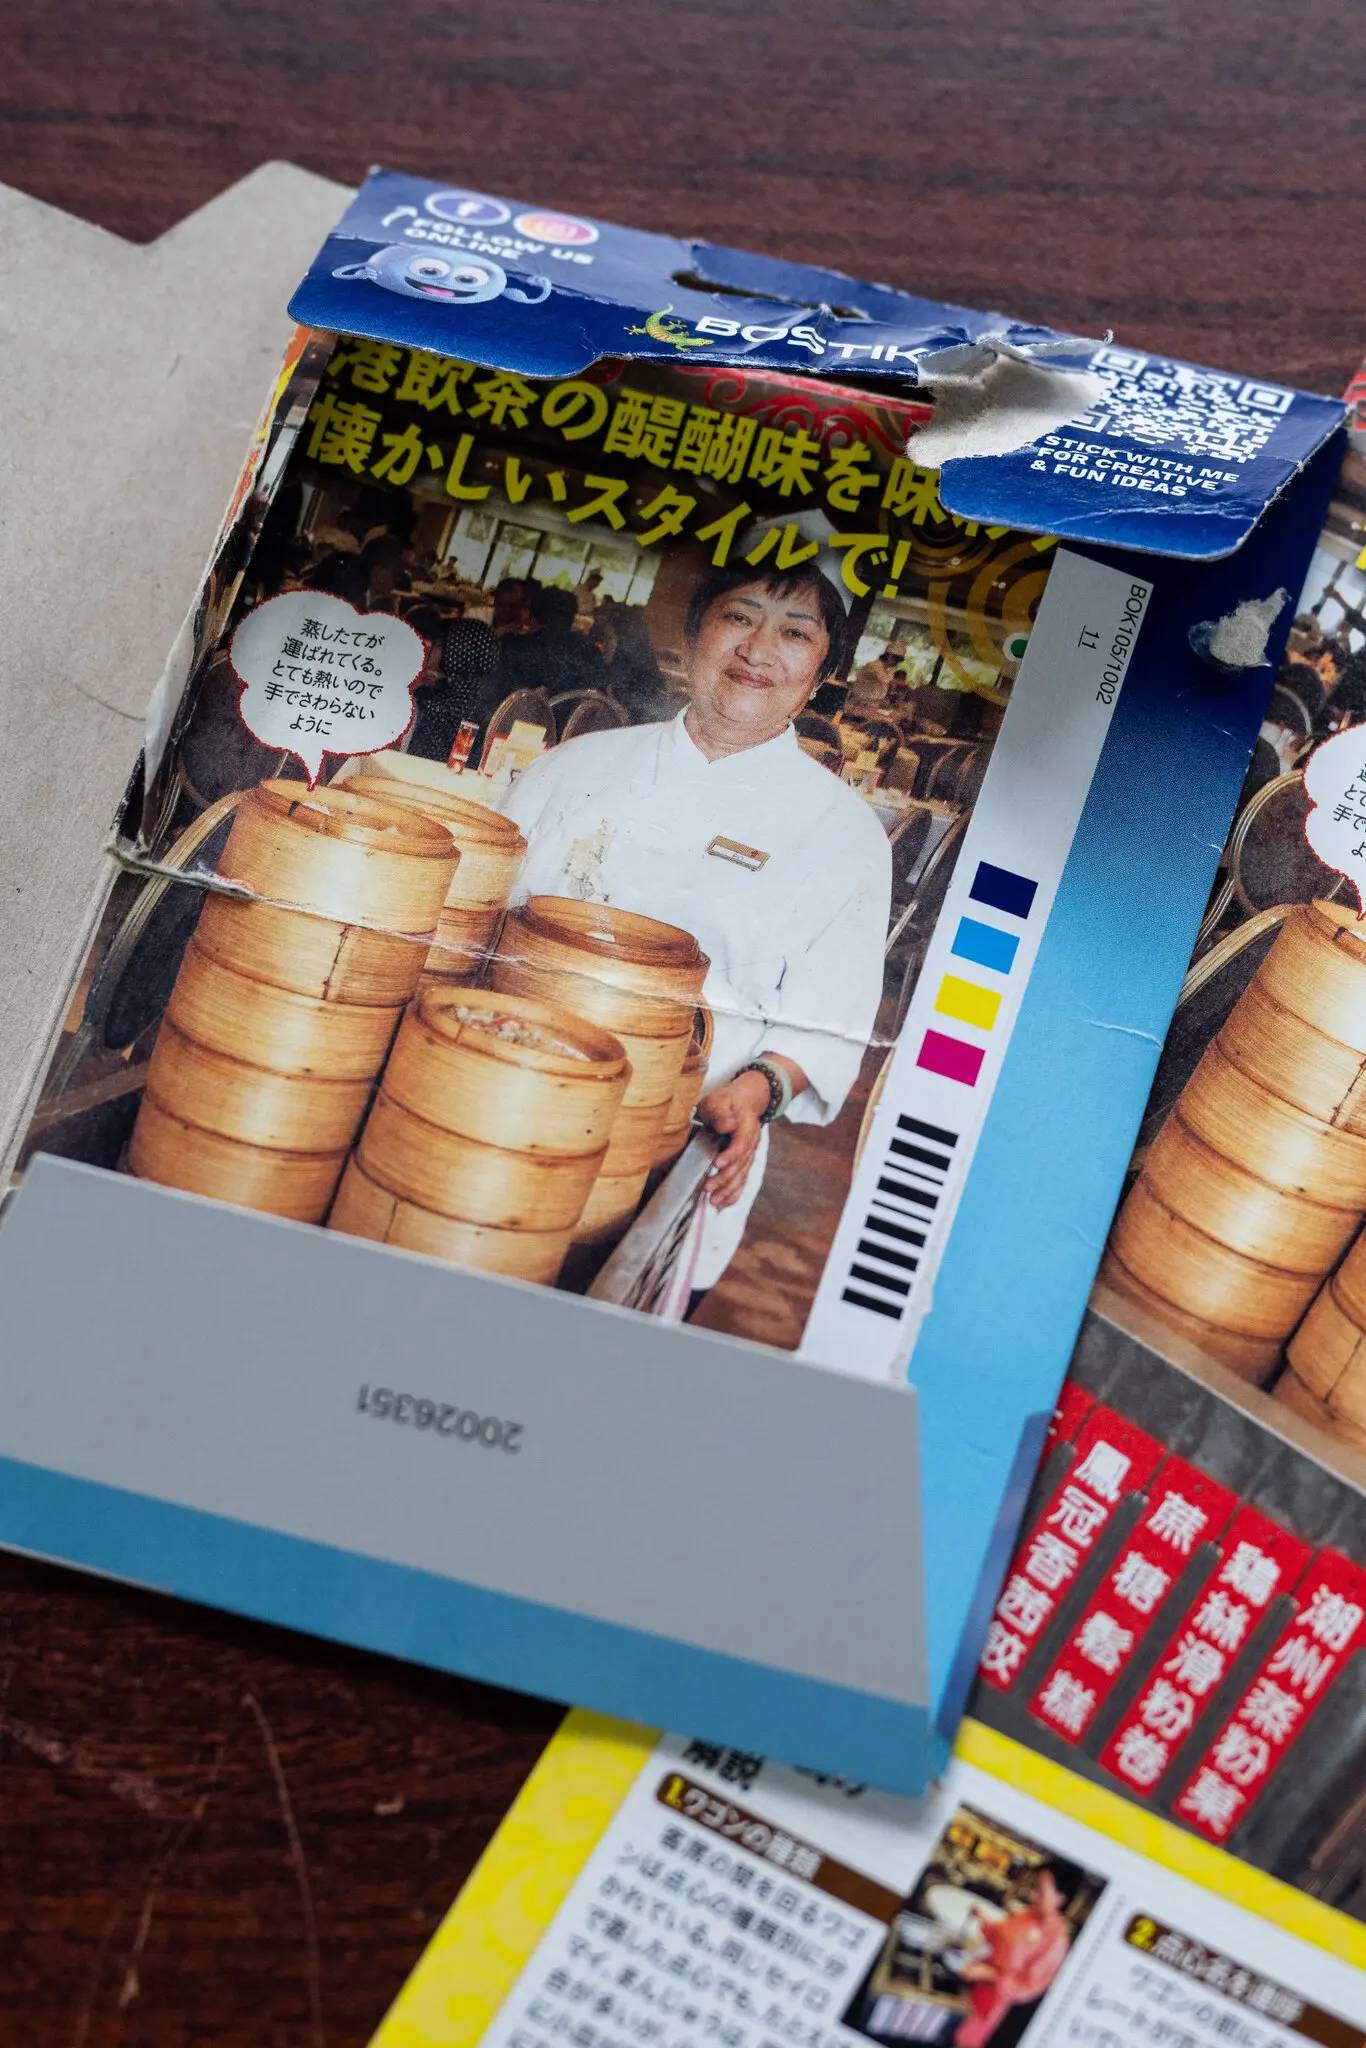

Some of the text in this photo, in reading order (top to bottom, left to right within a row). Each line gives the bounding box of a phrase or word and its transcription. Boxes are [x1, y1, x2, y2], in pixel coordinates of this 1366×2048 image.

[404, 227, 523, 261] ONLINE
[412, 217, 594, 265] FOLLOW US
[328, 337, 1060, 553] 港飲茶の醍醐味を味
[1043, 435, 1240, 483] STICK WITH ME
[1030, 459, 1188, 497] & FUN IDEAS
[1037, 447, 1219, 491] FOR CREATIVE
[300, 617, 386, 649] 蒸したてが
[1096, 583, 1148, 705] BOK105/1002
[281, 636, 383, 677] 運ばれてくる。
[271, 659, 384, 700] とても熱いので
[263, 681, 375, 720] 手でさわらない
[289, 714, 333, 735] ように
[357, 1383, 524, 1455] 20026351
